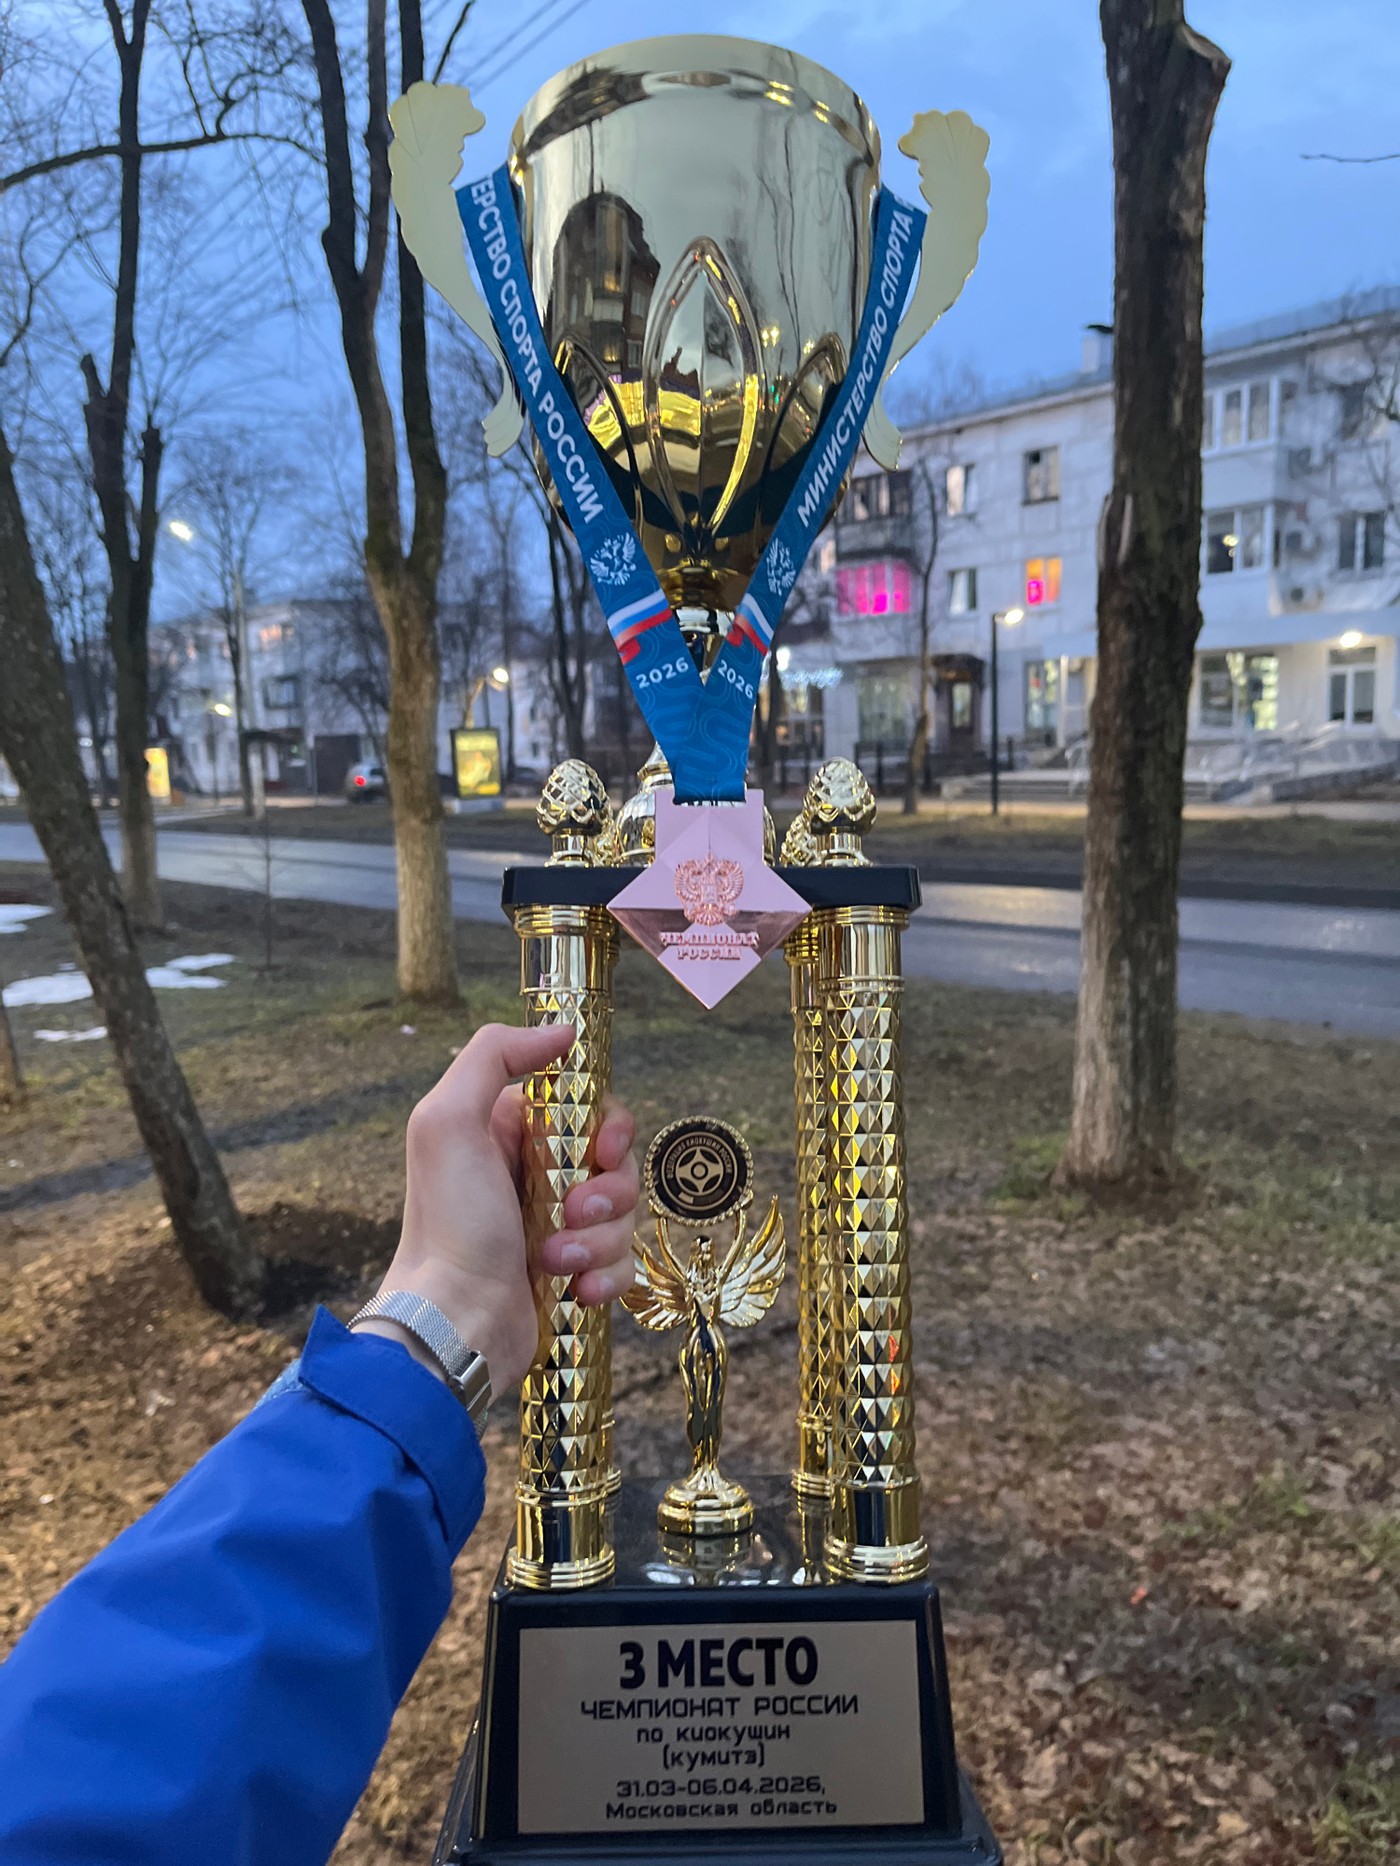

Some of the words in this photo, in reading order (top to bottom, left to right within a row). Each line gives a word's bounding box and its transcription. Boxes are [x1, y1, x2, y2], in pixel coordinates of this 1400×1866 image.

[797, 305, 888, 528] МИНИСТЕРСТВО
[880, 210, 914, 310] СПОРТА
[500, 278, 542, 398] СПОРТА
[538, 390, 604, 525] РОССИИ
[635, 656, 689, 689] 2026
[718, 659, 754, 700] 2026
[619, 1641, 646, 1690] 3
[657, 1636, 819, 1688] МЕСТО
[580, 1697, 742, 1720] ЧЕМПИОНАТ
[754, 1694, 859, 1716] РОССИИ
[637, 1728, 663, 1744] по
[676, 1723, 791, 1747] киокушин
[662, 1741, 766, 1772] (кумитэ)
[616, 1775, 827, 1798] 31.03-06.04.2026,
[606, 1801, 739, 1820] Московская
[750, 1798, 838, 1815] область
